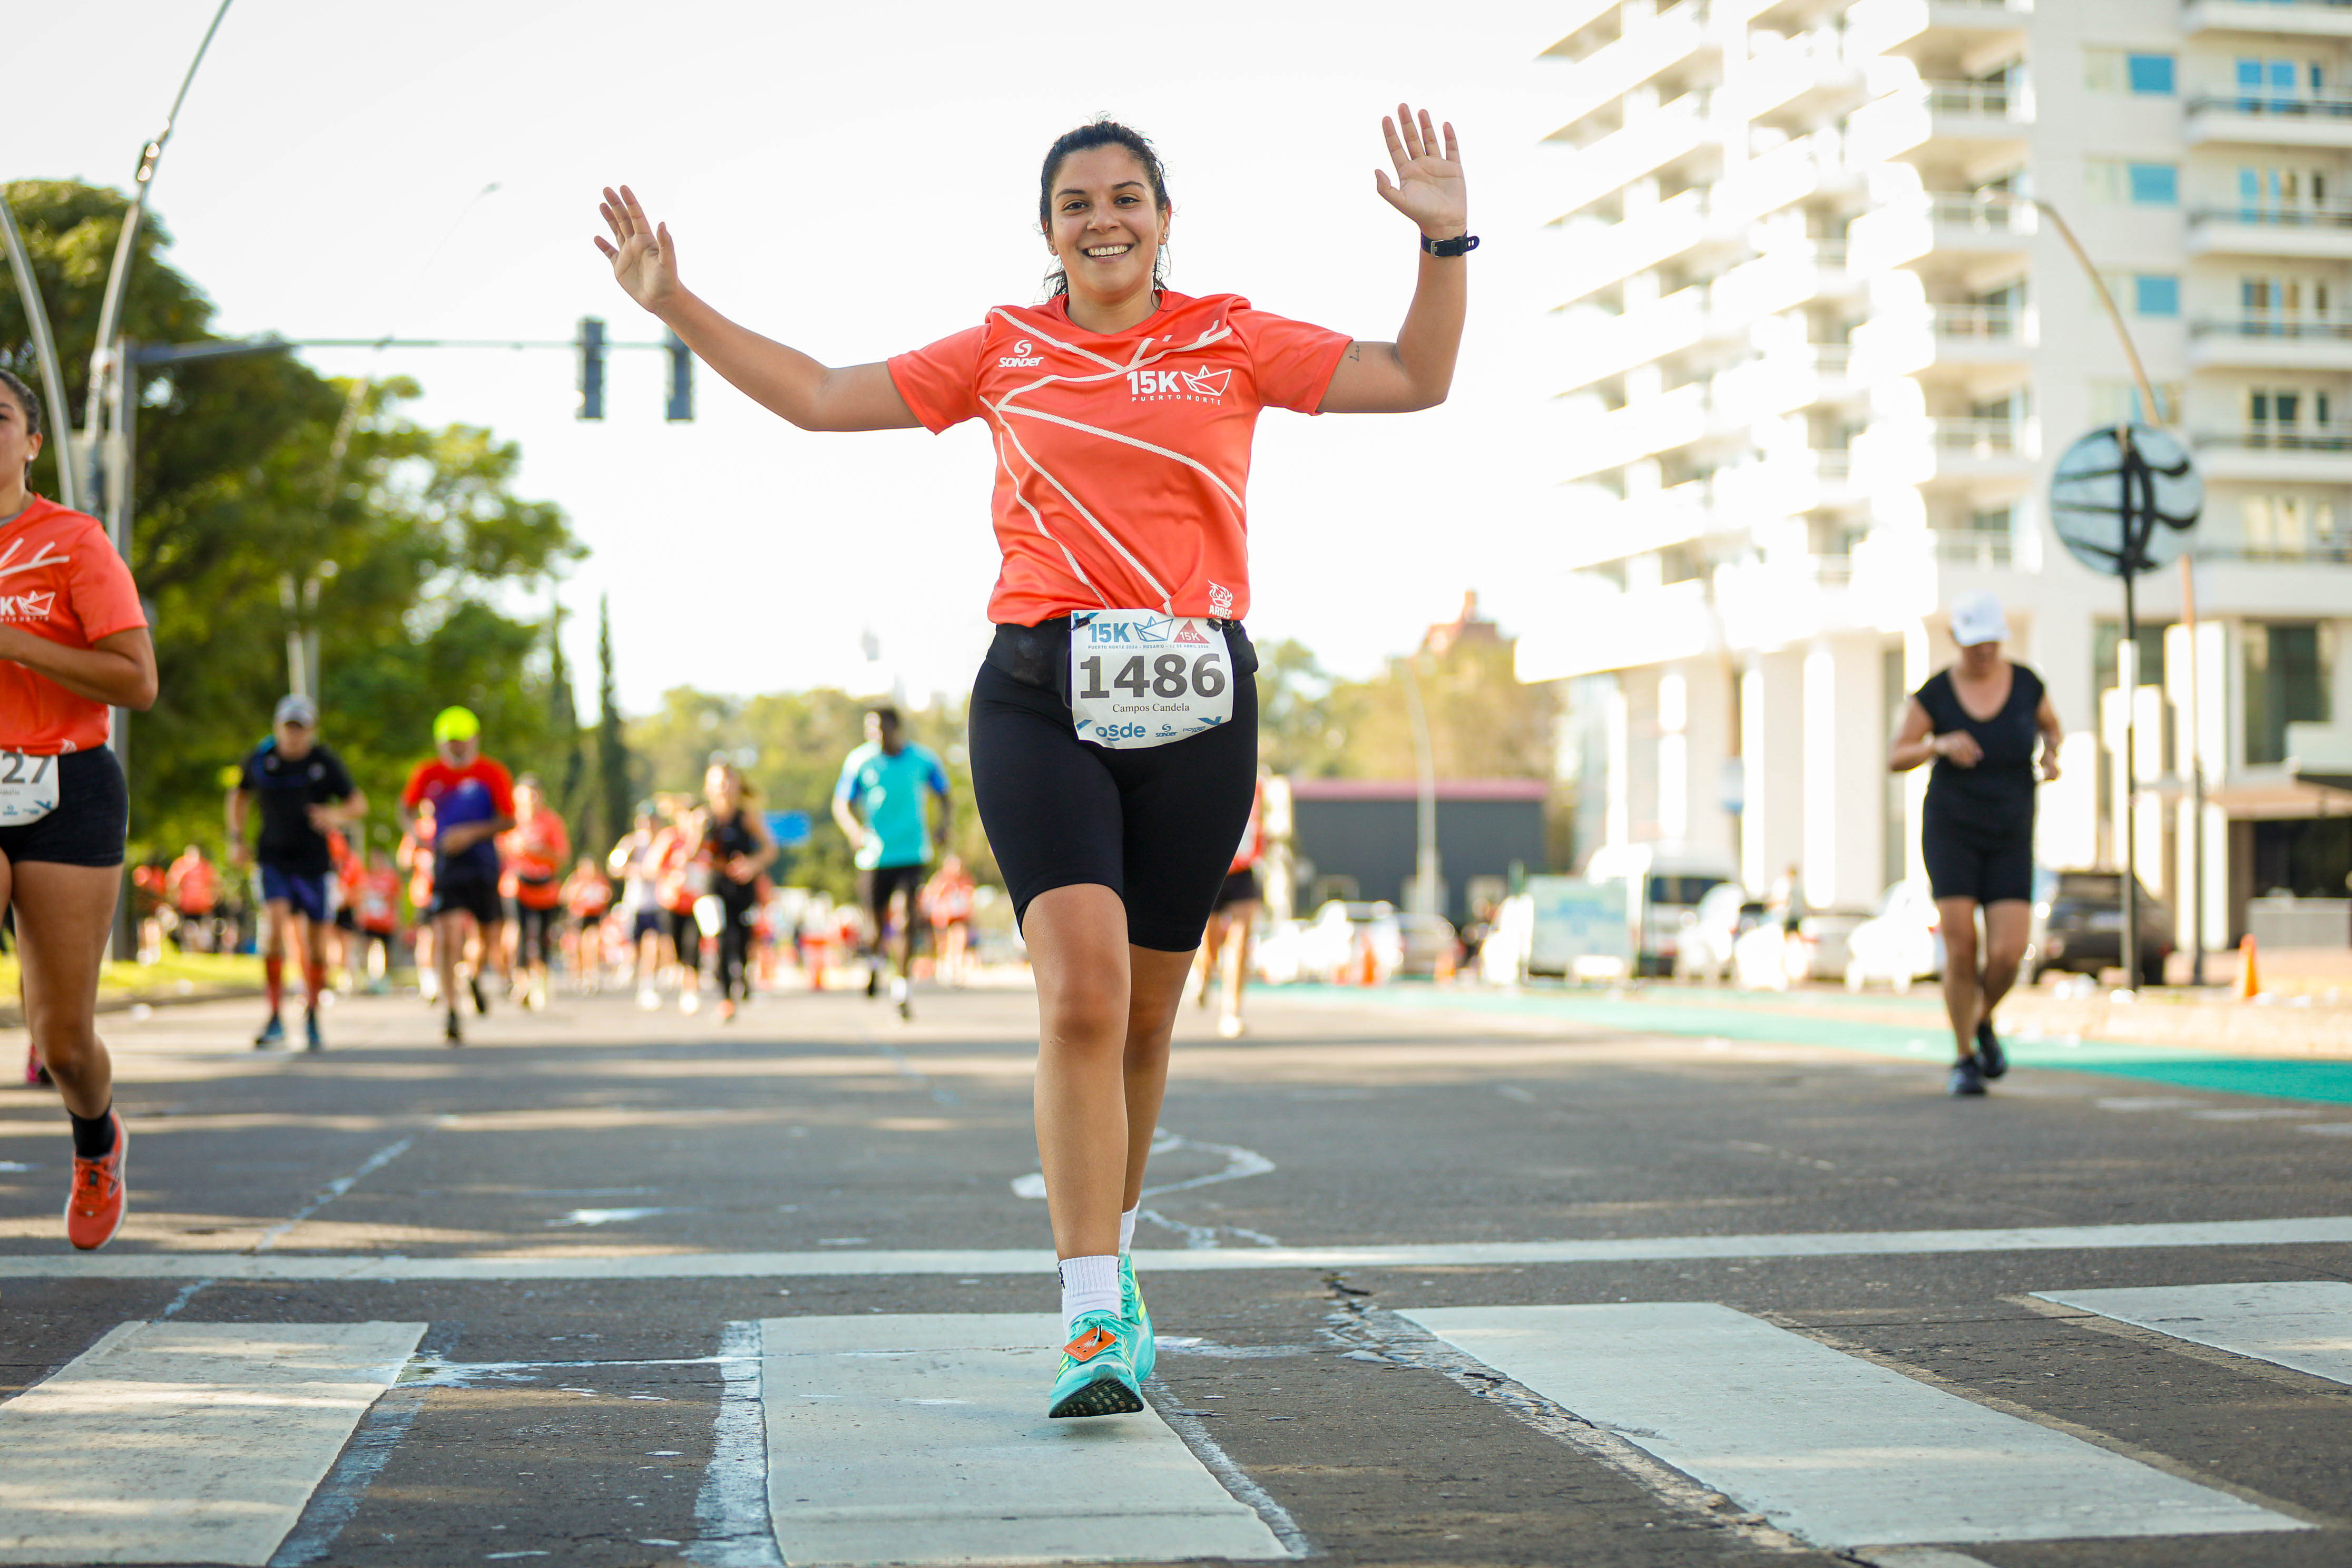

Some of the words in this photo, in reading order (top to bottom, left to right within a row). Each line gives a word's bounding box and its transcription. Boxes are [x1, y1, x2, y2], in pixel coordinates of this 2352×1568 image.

[1126, 370, 1181, 394] 15K
[1132, 394, 1181, 403] PUERTO
[1186, 395, 1221, 405] NORTE
[1209, 604, 1232, 619] ARDEC
[1087, 622, 1130, 643] 15K
[1179, 631, 1201, 641] 15K
[1080, 653, 1226, 699] 1486
[1112, 703, 1150, 714] Campos
[1152, 703, 1190, 712] Candela
[1095, 722, 1146, 740] osde
